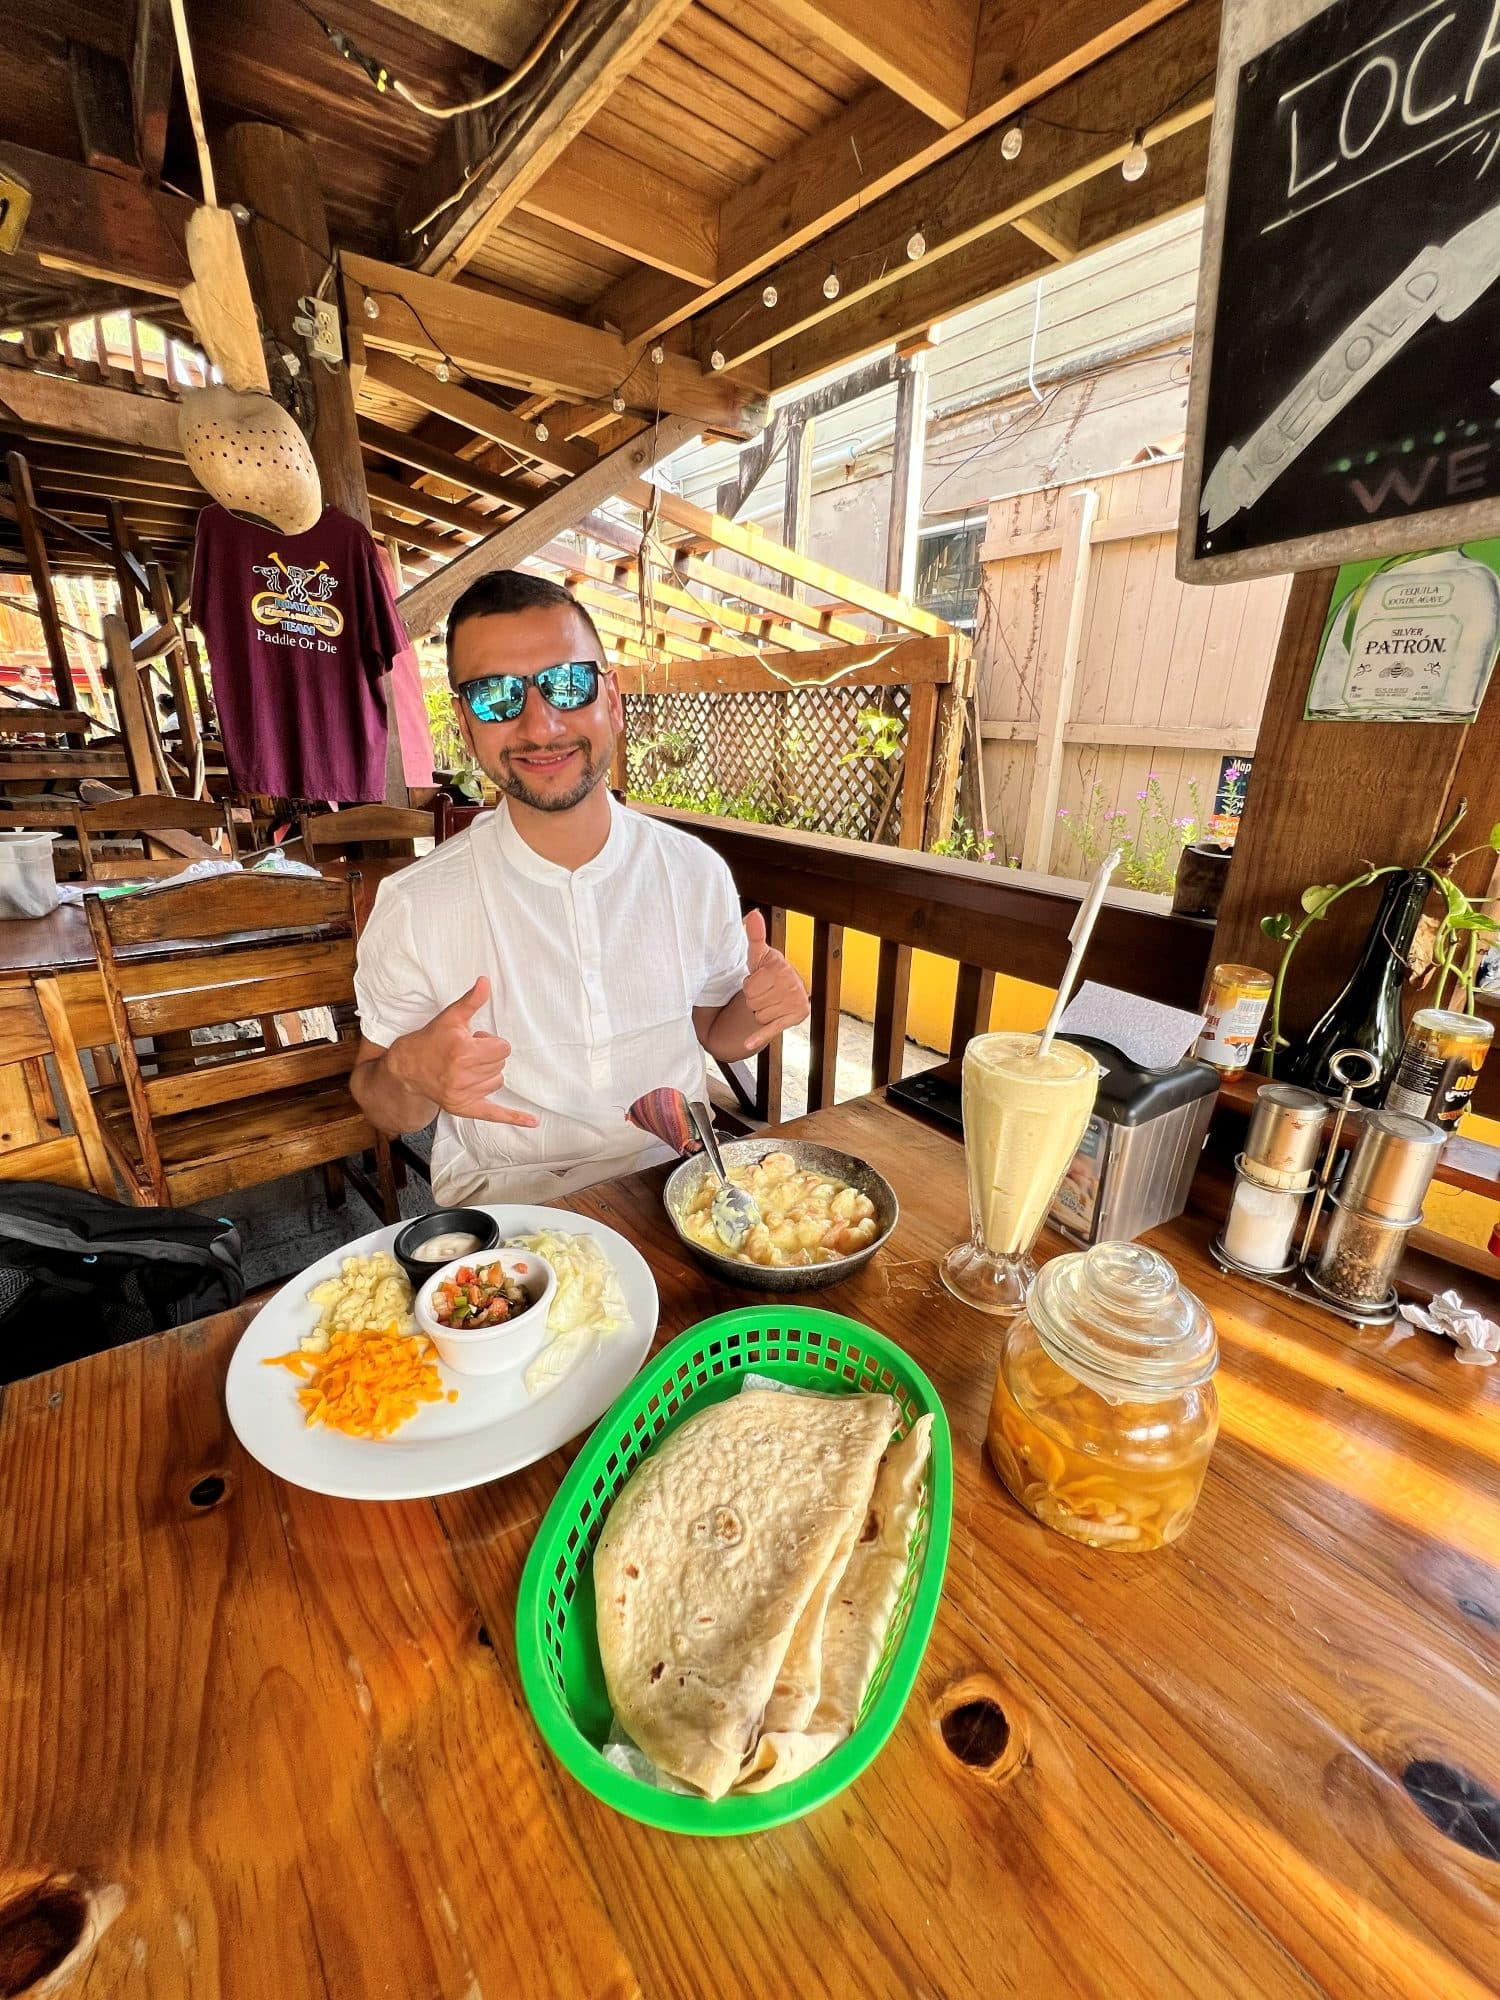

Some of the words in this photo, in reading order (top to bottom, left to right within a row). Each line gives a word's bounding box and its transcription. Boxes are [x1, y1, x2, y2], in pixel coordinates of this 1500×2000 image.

[1400, 586, 1439, 596] TEQUILA
[281, 620, 316, 636] TEAM
[1391, 627, 1424, 637] SILVER
[256, 629, 297, 647] Paddle
[299, 637, 315, 650] Or
[318, 640, 337, 654] Die
